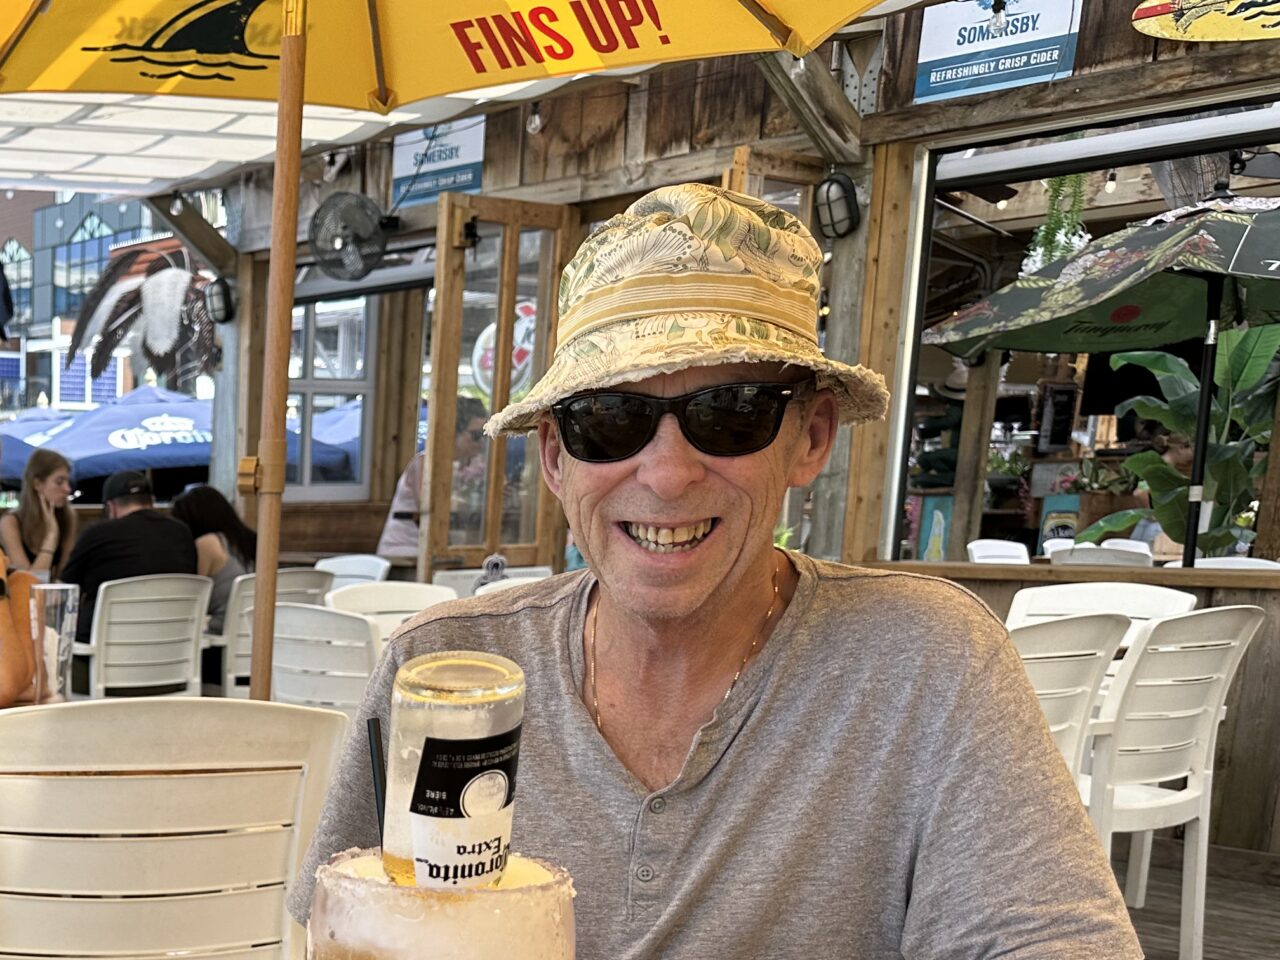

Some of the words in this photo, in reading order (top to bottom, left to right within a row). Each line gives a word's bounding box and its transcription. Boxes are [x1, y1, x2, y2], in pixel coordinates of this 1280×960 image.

[449, 6, 574, 73] FINS
[569, 0, 671, 54] UP!
[929, 61, 996, 83] REFRESHINGLY
[998, 56, 1027, 71] CRISP
[1030, 50, 1059, 65] CIDER
[107, 427, 213, 450] Coron
[456, 836, 502, 856] Extra
